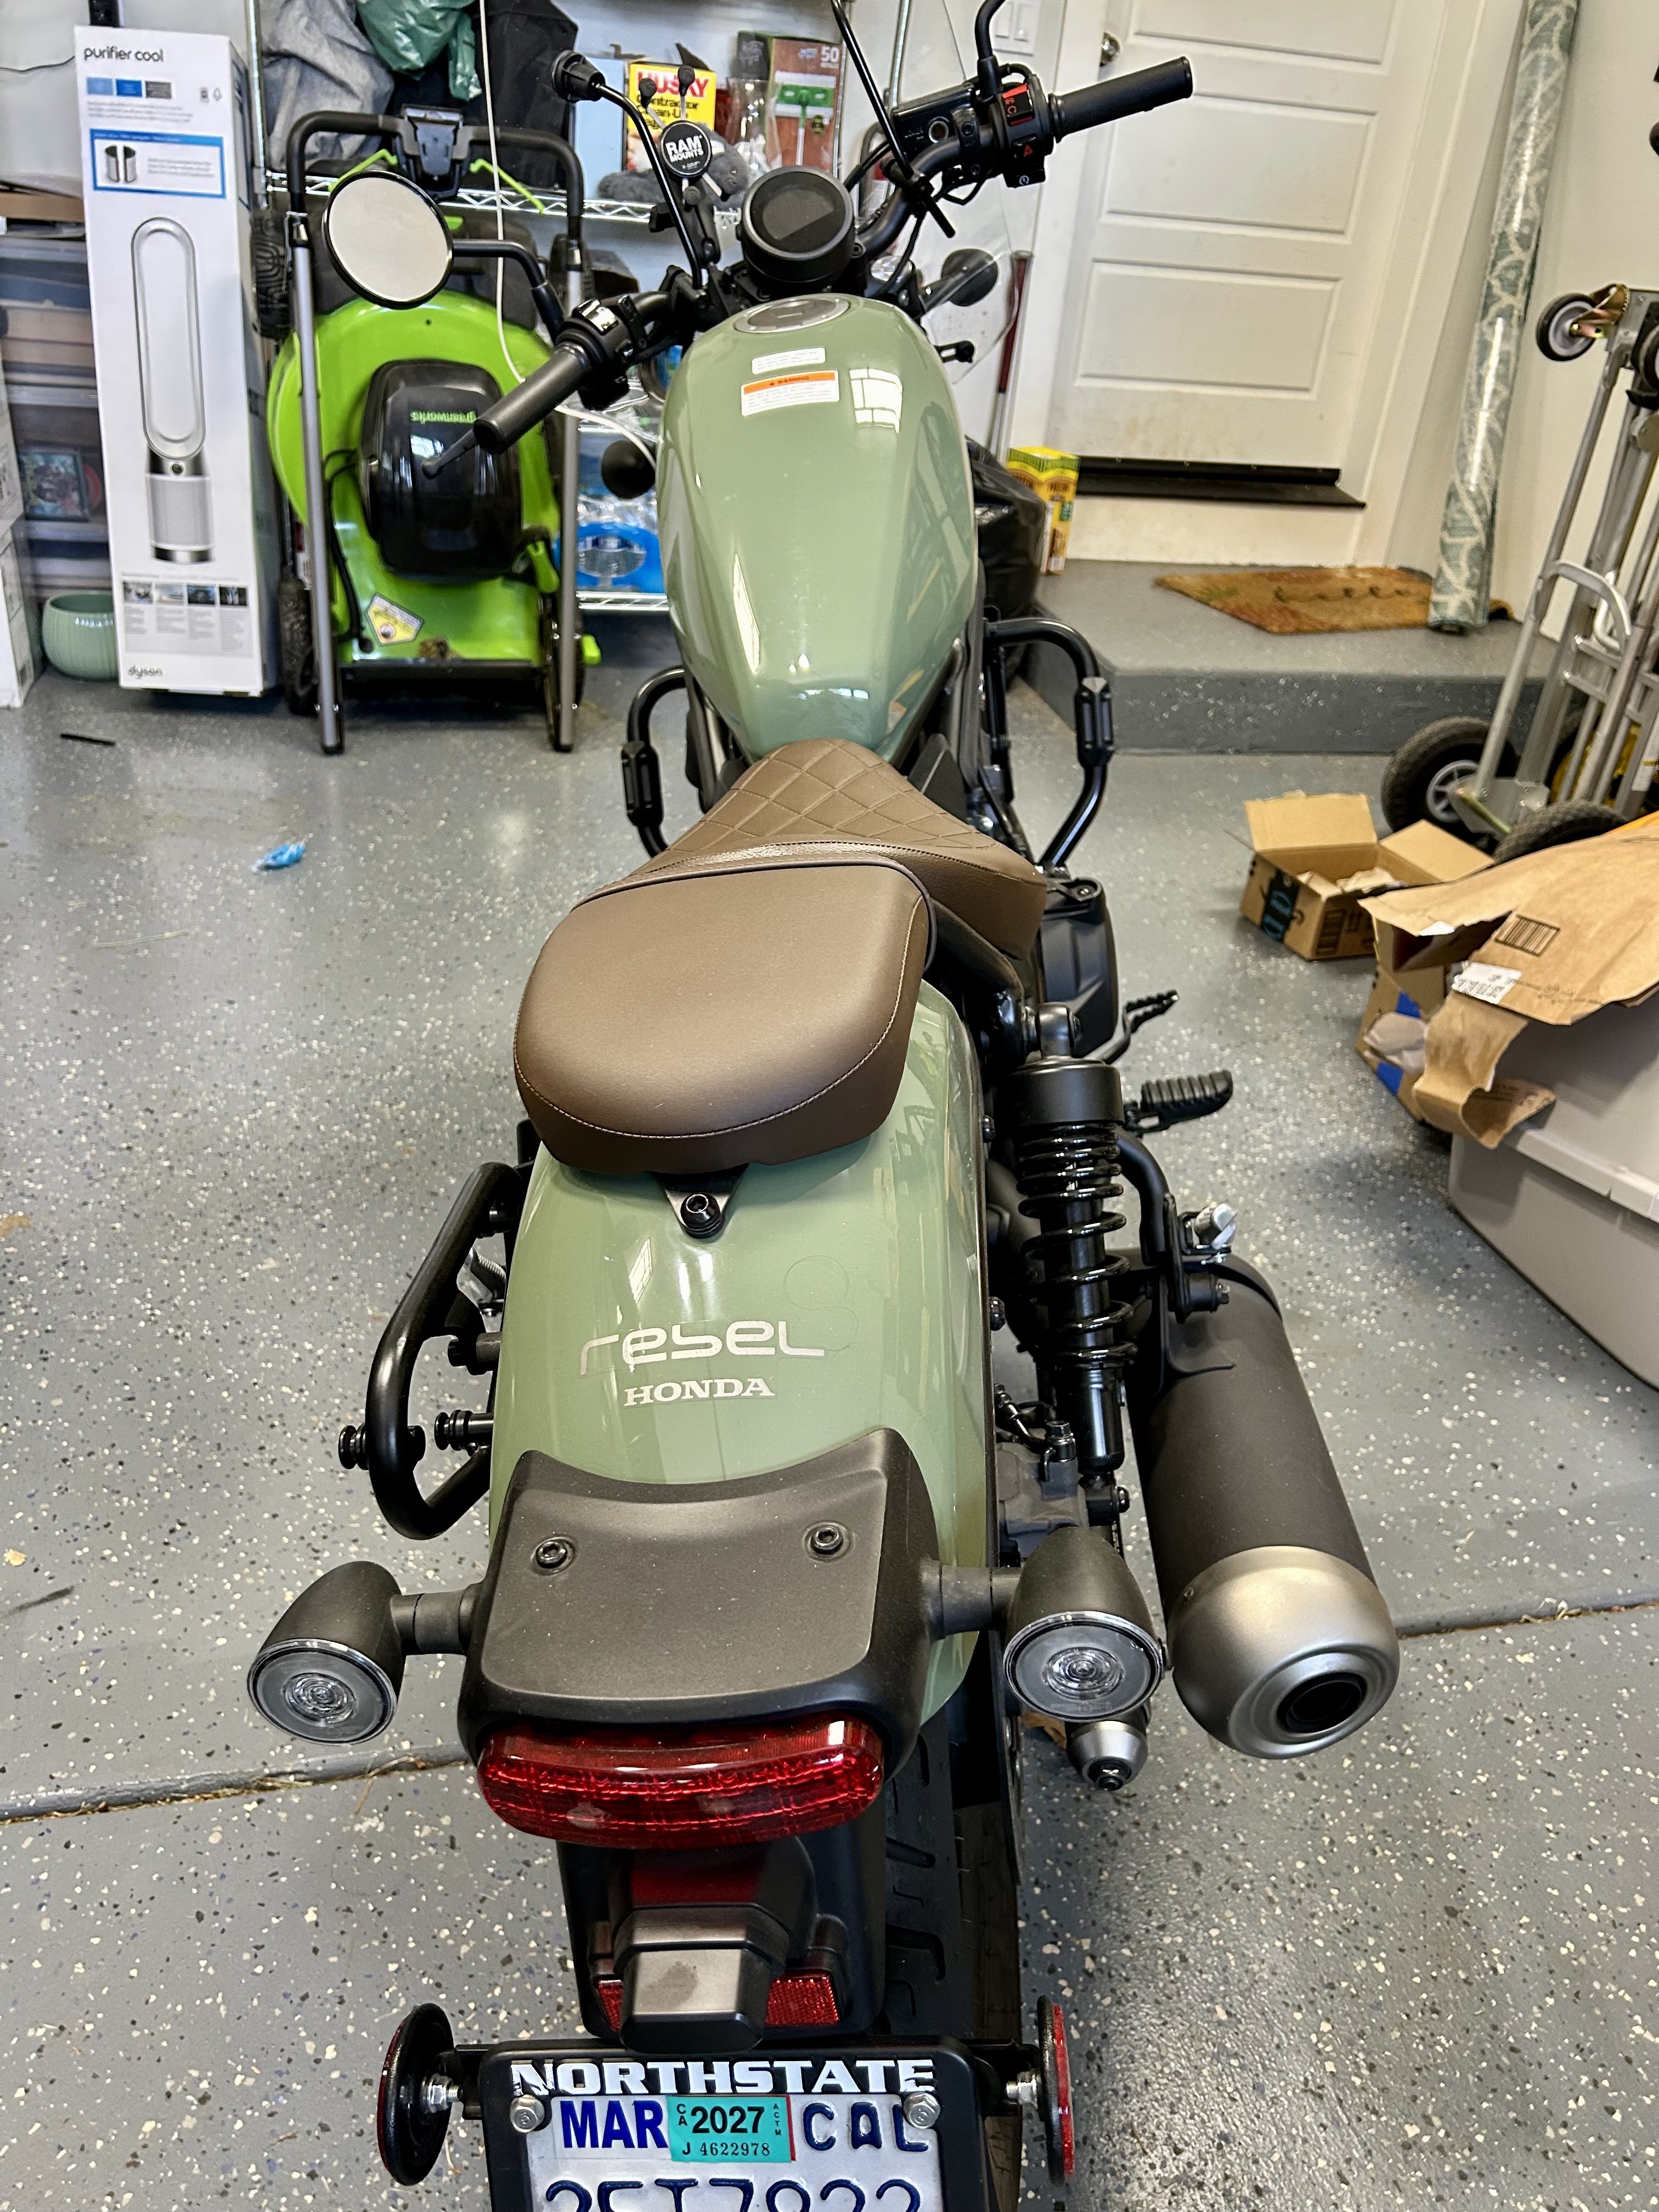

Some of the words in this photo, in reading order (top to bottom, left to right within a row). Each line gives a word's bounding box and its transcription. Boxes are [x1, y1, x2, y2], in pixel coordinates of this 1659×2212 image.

[84, 46, 132, 61] purifier
[134, 48, 163, 61] cool
[821, 46, 840, 63] 50
[665, 136, 702, 156] RAM
[669, 148, 704, 162] MOUNTS
[410, 410, 476, 425] greenworks
[127, 663, 163, 679] dyson
[624, 1378, 775, 1407] HONDA
[510, 2059, 935, 2096] NORTHSTATE
[560, 2100, 669, 2148] MAR
[691, 2106, 765, 2134] 2027
[803, 2101, 929, 2152] CAL
[682, 2142, 691, 2155] J
[699, 2142, 770, 2156] 4622978
